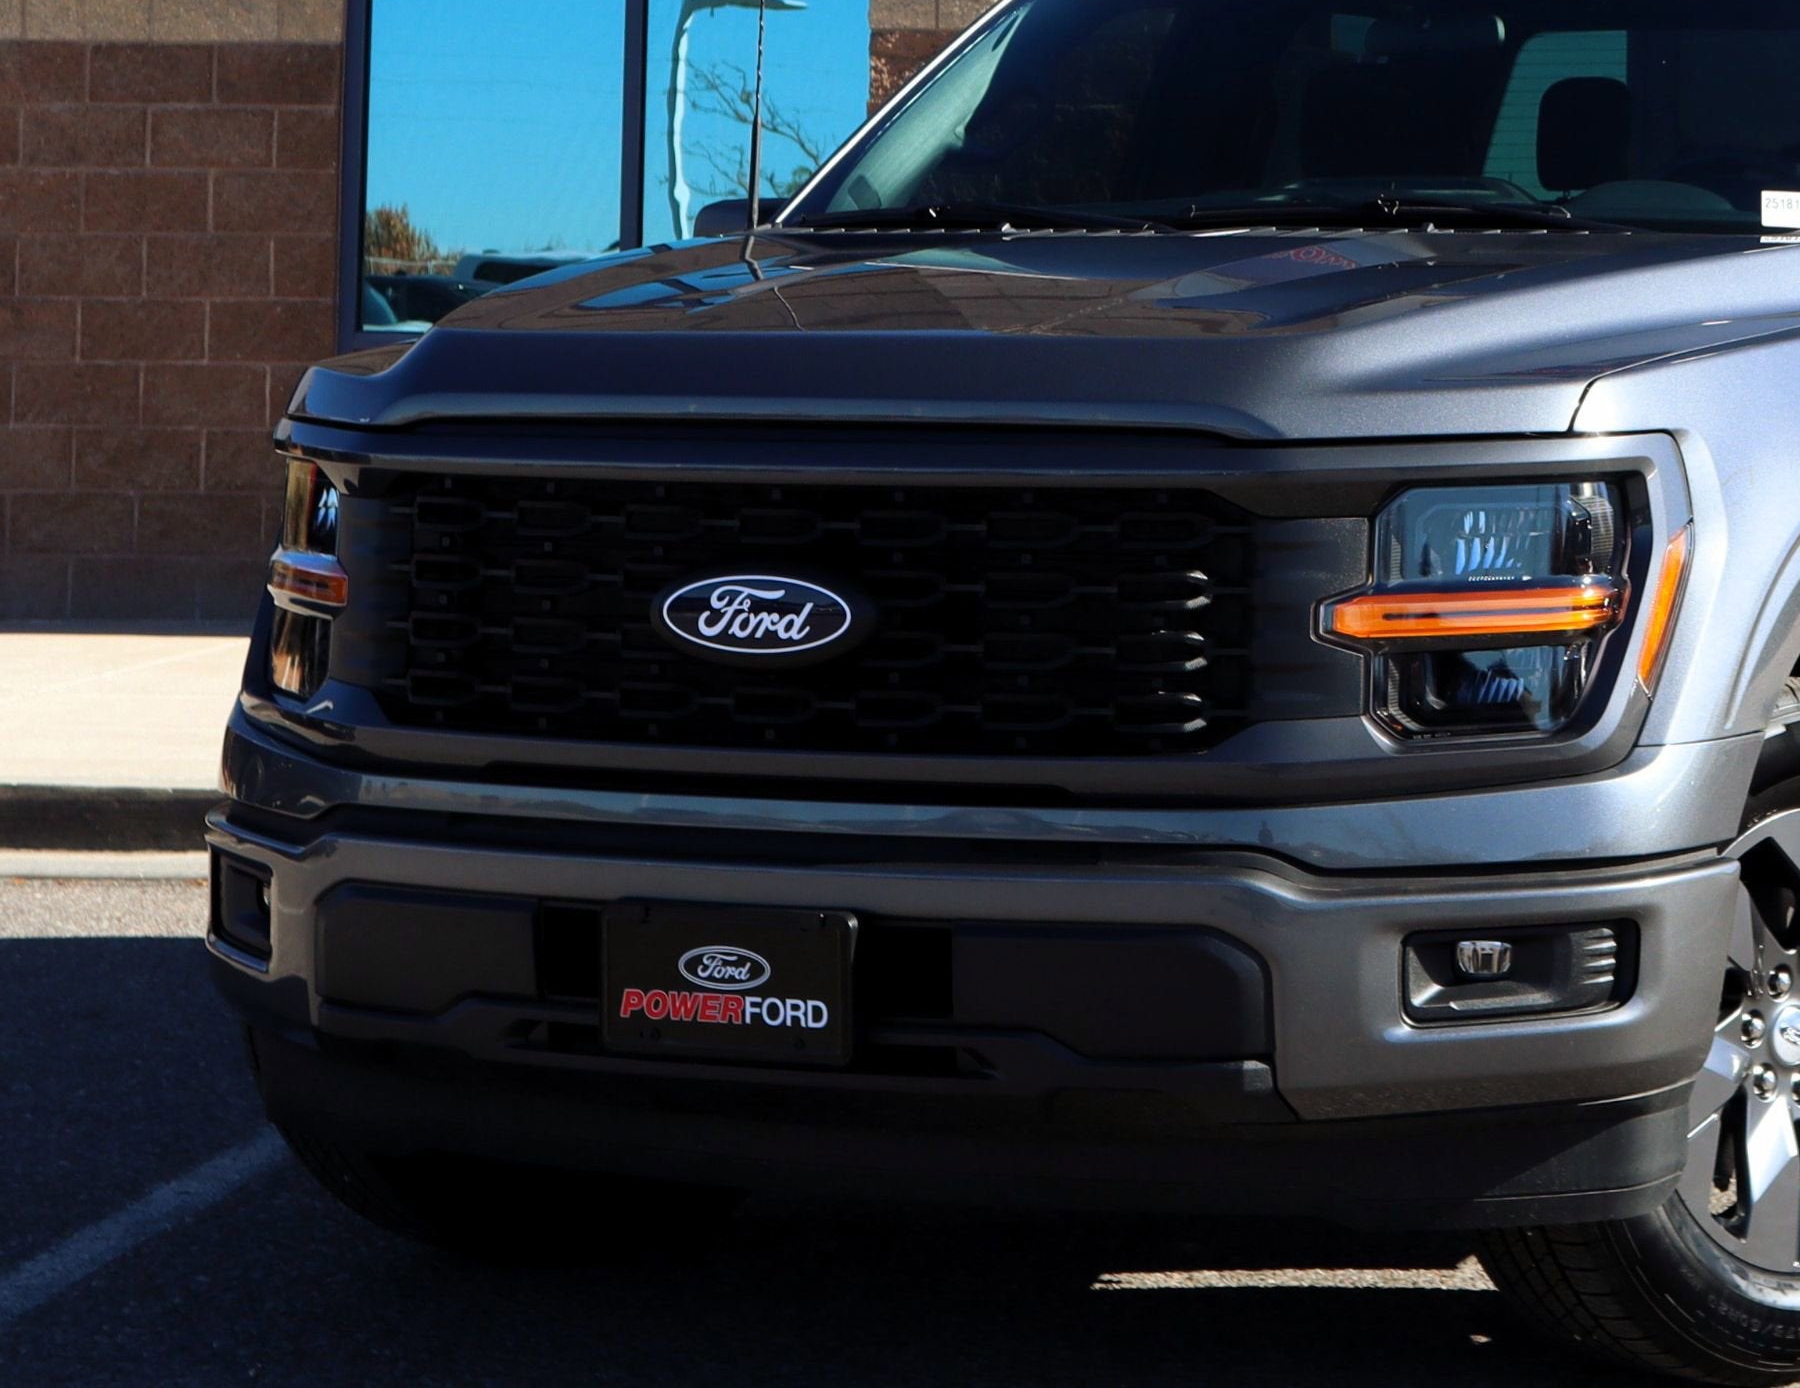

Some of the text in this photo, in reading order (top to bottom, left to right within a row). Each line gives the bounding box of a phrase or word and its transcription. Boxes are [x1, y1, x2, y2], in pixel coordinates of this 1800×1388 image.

[698, 585, 812, 640] Ford
[697, 955, 751, 981] Ford
[619, 988, 829, 1029] POWERFORD
